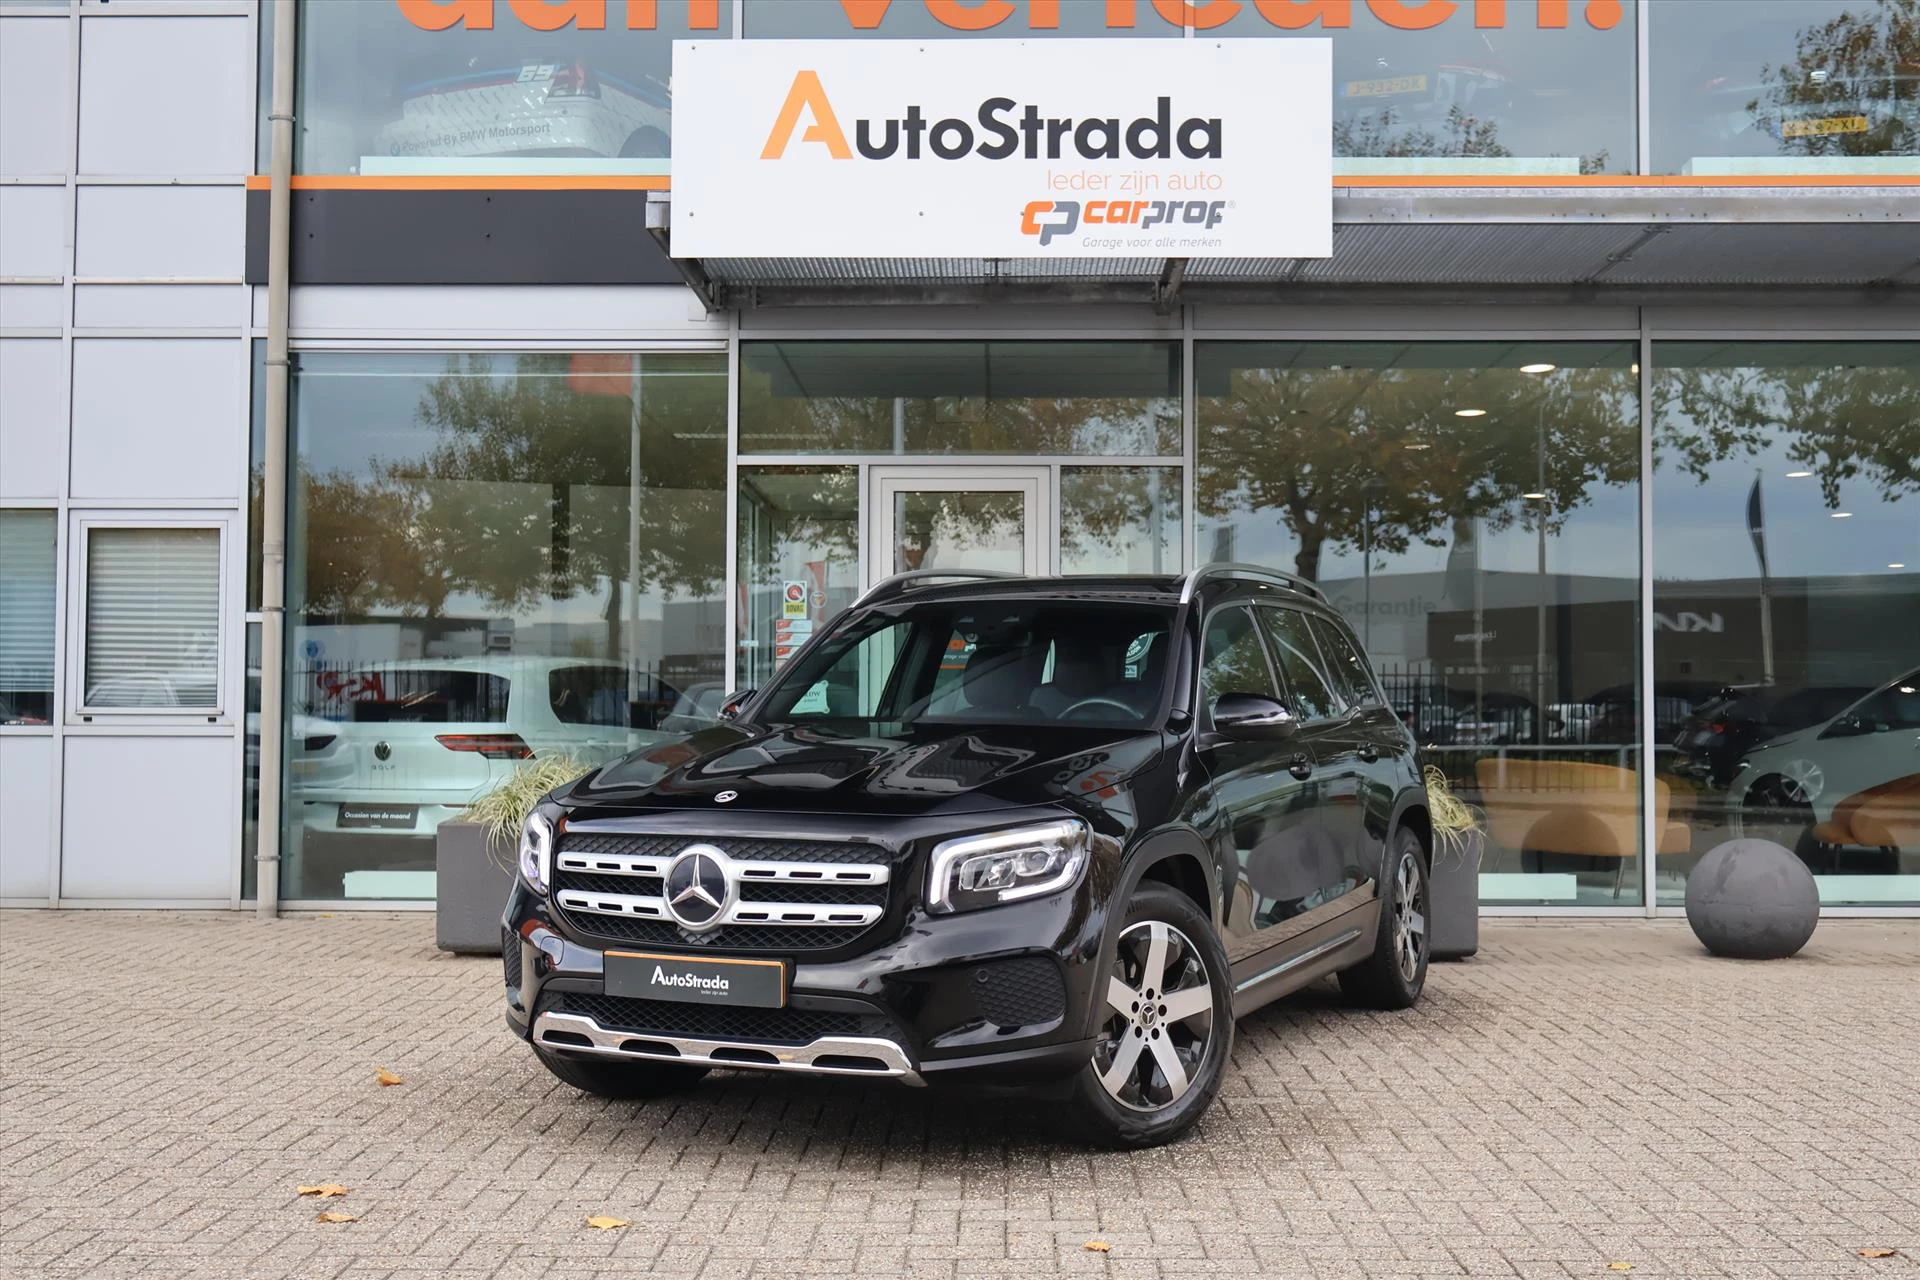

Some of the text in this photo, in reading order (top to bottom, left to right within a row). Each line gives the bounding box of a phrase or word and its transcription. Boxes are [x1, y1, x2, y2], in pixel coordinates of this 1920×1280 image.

[759, 70, 1222, 160] AutoStrada
[459, 129, 487, 143] BMW
[488, 123, 551, 138] Motorsport
[1119, 170, 1159, 196] zijn
[1167, 171, 1223, 191] auto
[1082, 237, 1222, 249] Garage voor alle merken
[650, 965, 729, 990] AutoStrada
